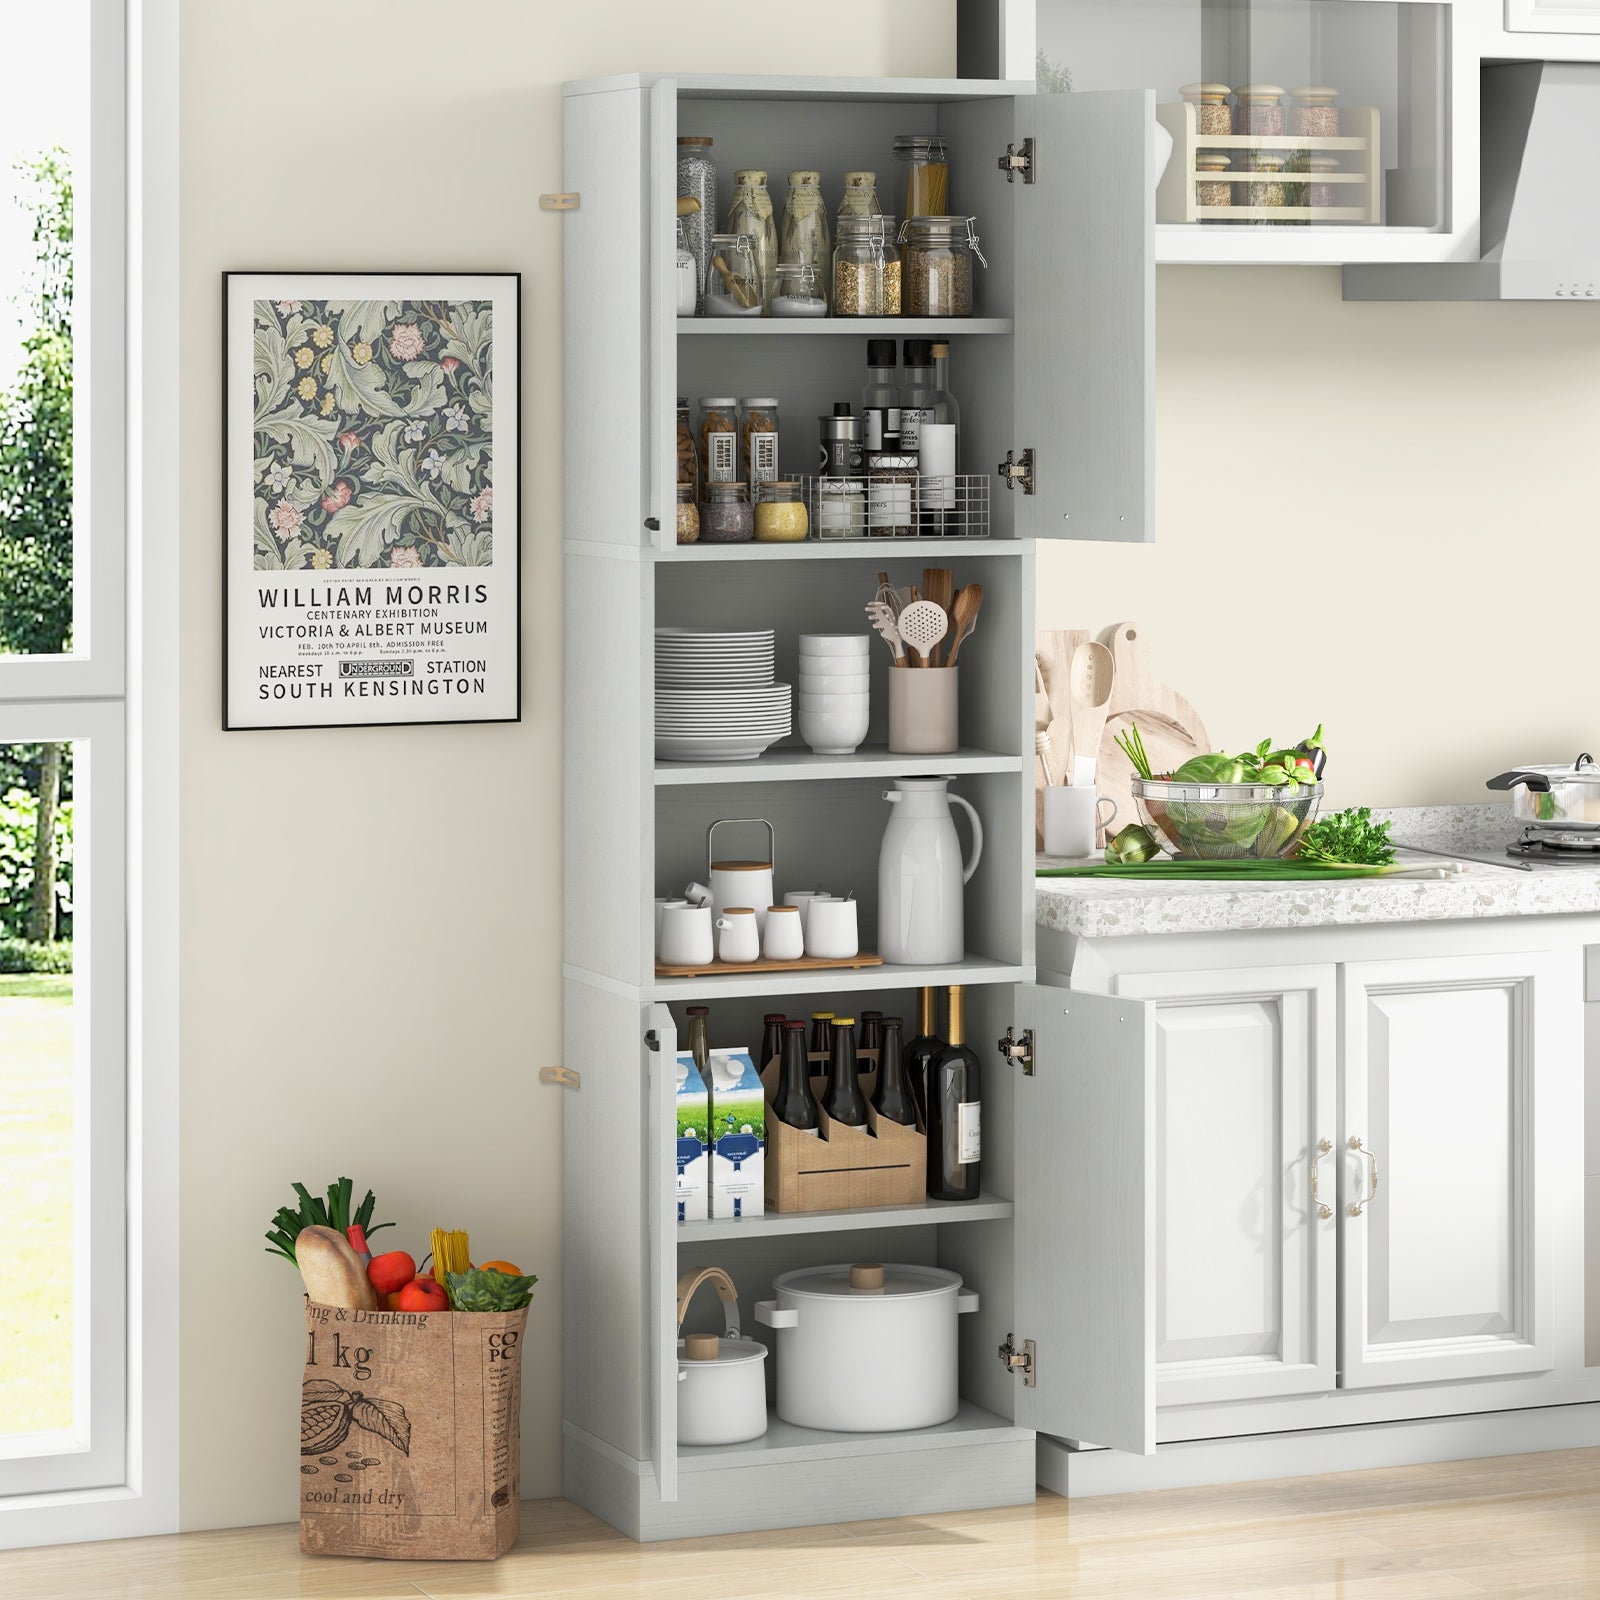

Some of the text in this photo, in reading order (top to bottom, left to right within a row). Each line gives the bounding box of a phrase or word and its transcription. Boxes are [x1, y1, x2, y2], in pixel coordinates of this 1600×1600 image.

[258, 584, 488, 608] WILLIAM MORRIS
[306, 608, 438, 621] CENTENARY EXHIBITION
[259, 621, 488, 639] VICTORIA & ALBERT MUSEUM
[386, 640, 425, 648] ADMISSION
[259, 660, 487, 679] NEAREST UNDERGROUND STATION
[259, 678, 485, 700] SOUTH KENSINGTON
[335, 1306, 347, 1321] &
[352, 1308, 429, 1330] Drinking
[332, 1332, 374, 1381] kg
[305, 1482, 406, 1510] cool and dry
